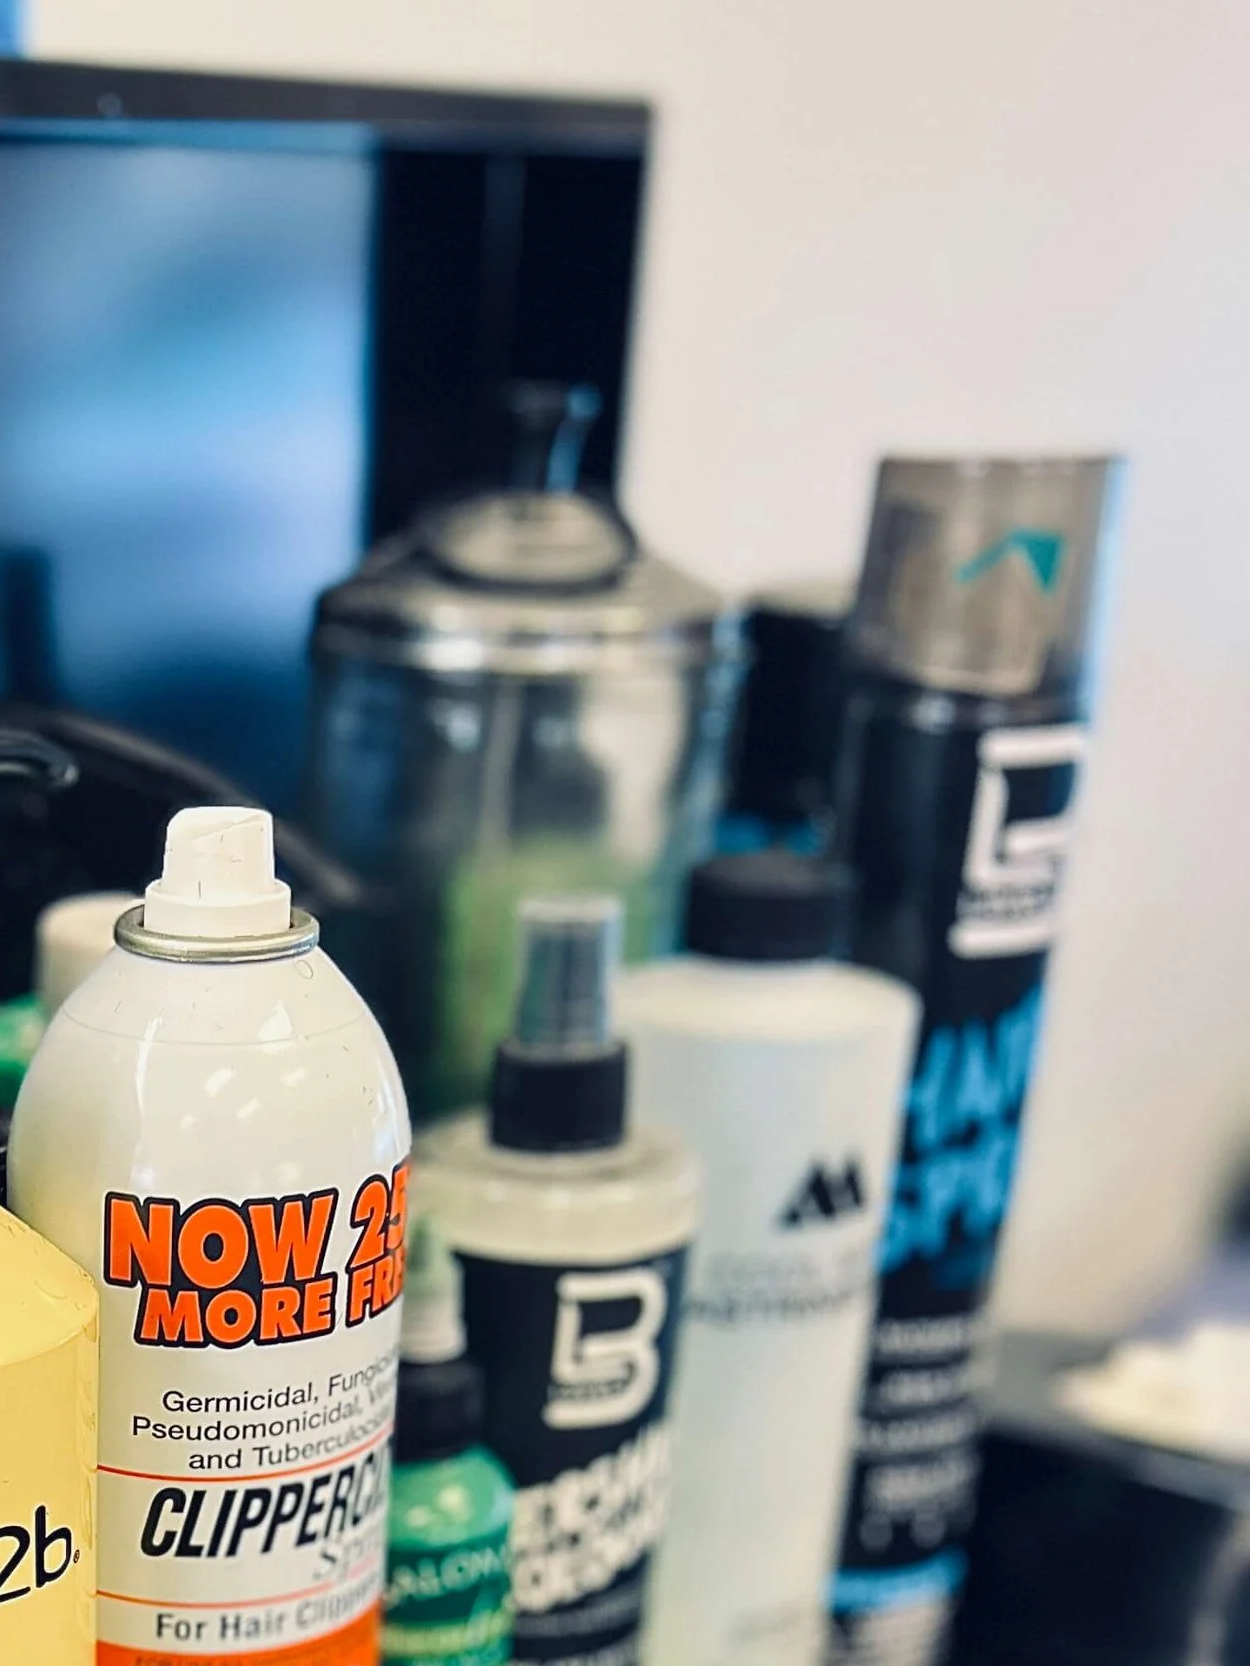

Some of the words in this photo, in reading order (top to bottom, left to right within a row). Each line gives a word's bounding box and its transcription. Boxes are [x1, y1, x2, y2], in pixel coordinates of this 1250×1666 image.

[106, 1190, 337, 1292] NOW
[136, 1278, 335, 1346] MORE
[132, 1395, 363, 1441] Pseudomonicidal,
[162, 1382, 319, 1412] Germicidal,
[188, 1448, 242, 1469] and
[156, 1613, 209, 1641] For
[219, 1604, 287, 1642] Hair
